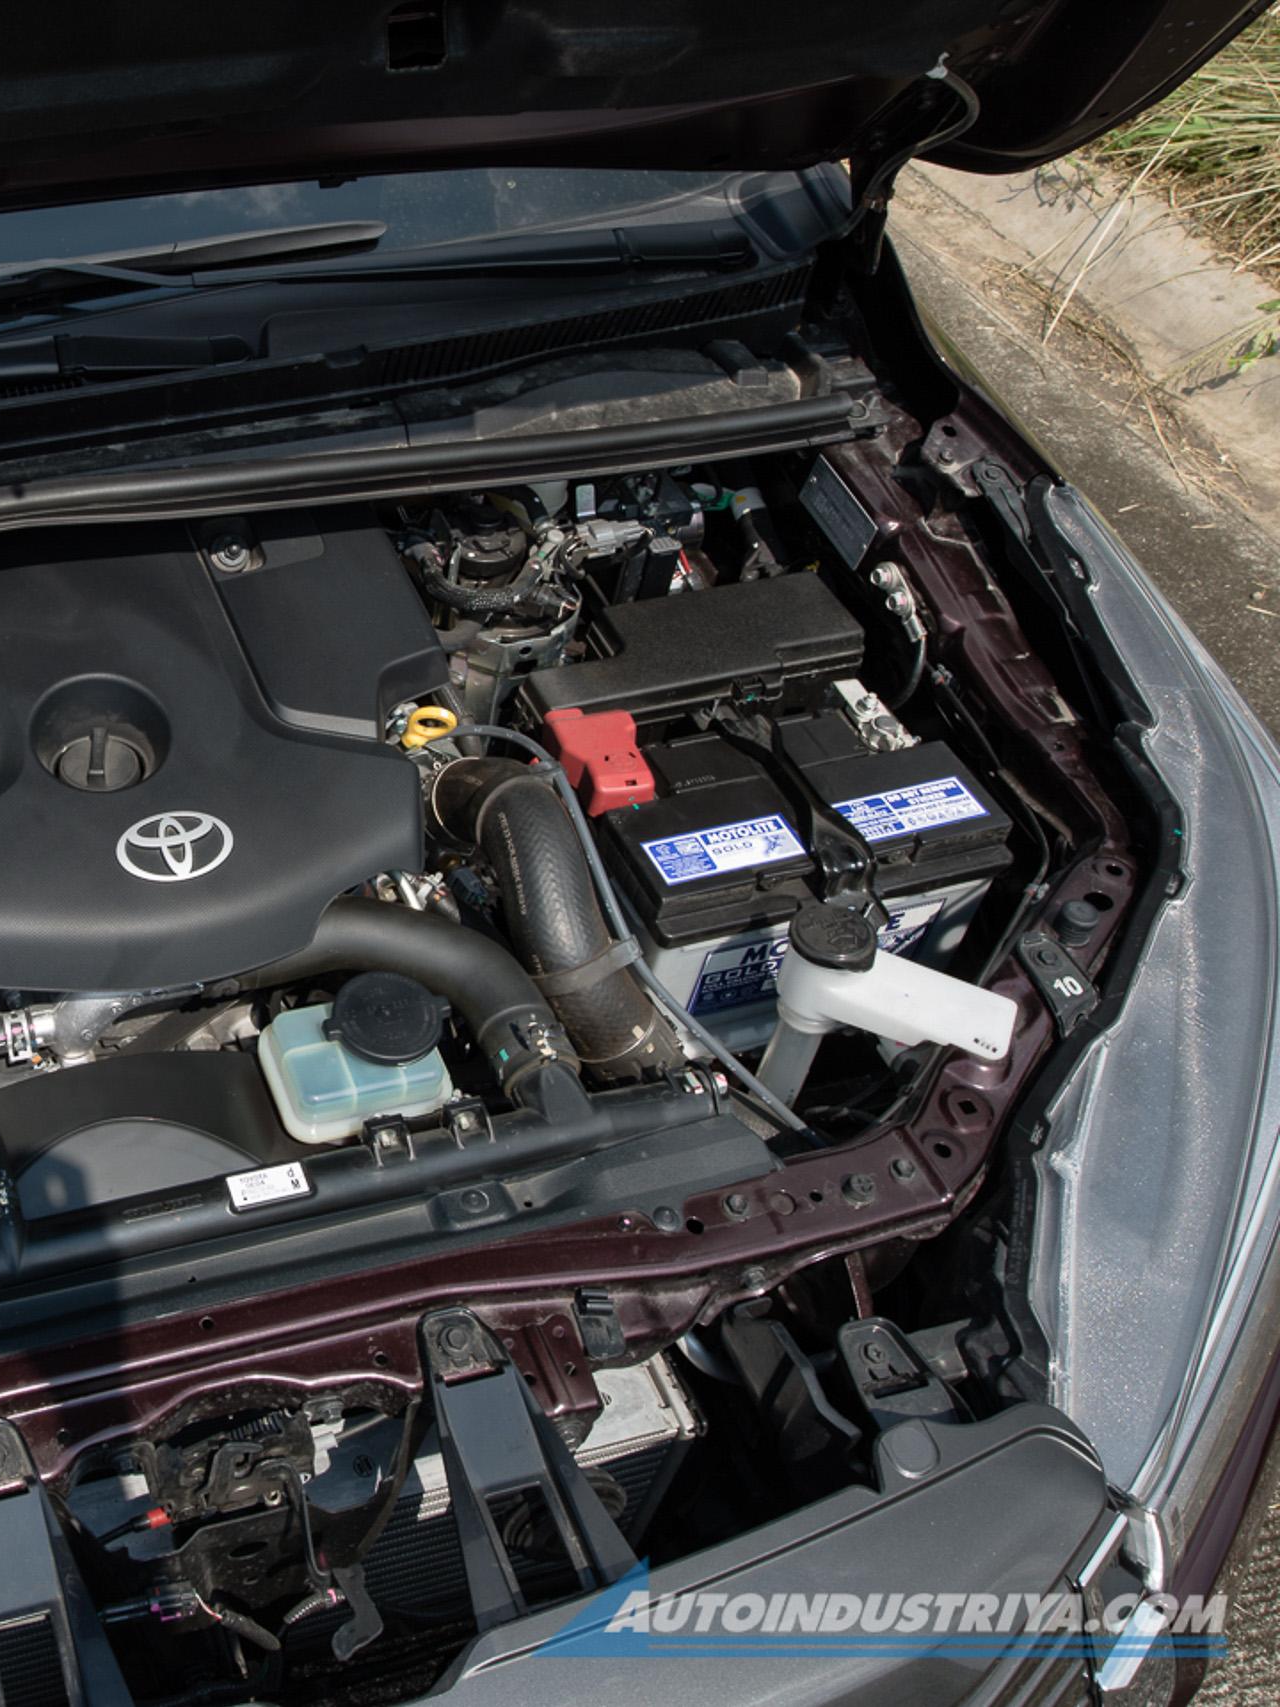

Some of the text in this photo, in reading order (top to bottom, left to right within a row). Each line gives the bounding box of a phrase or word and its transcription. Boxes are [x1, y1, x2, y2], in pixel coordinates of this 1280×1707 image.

[707, 819, 779, 844] MOTOLITE
[712, 841, 754, 856] GOLD
[704, 961, 777, 984] GOLD
[1053, 975, 1084, 998] 10
